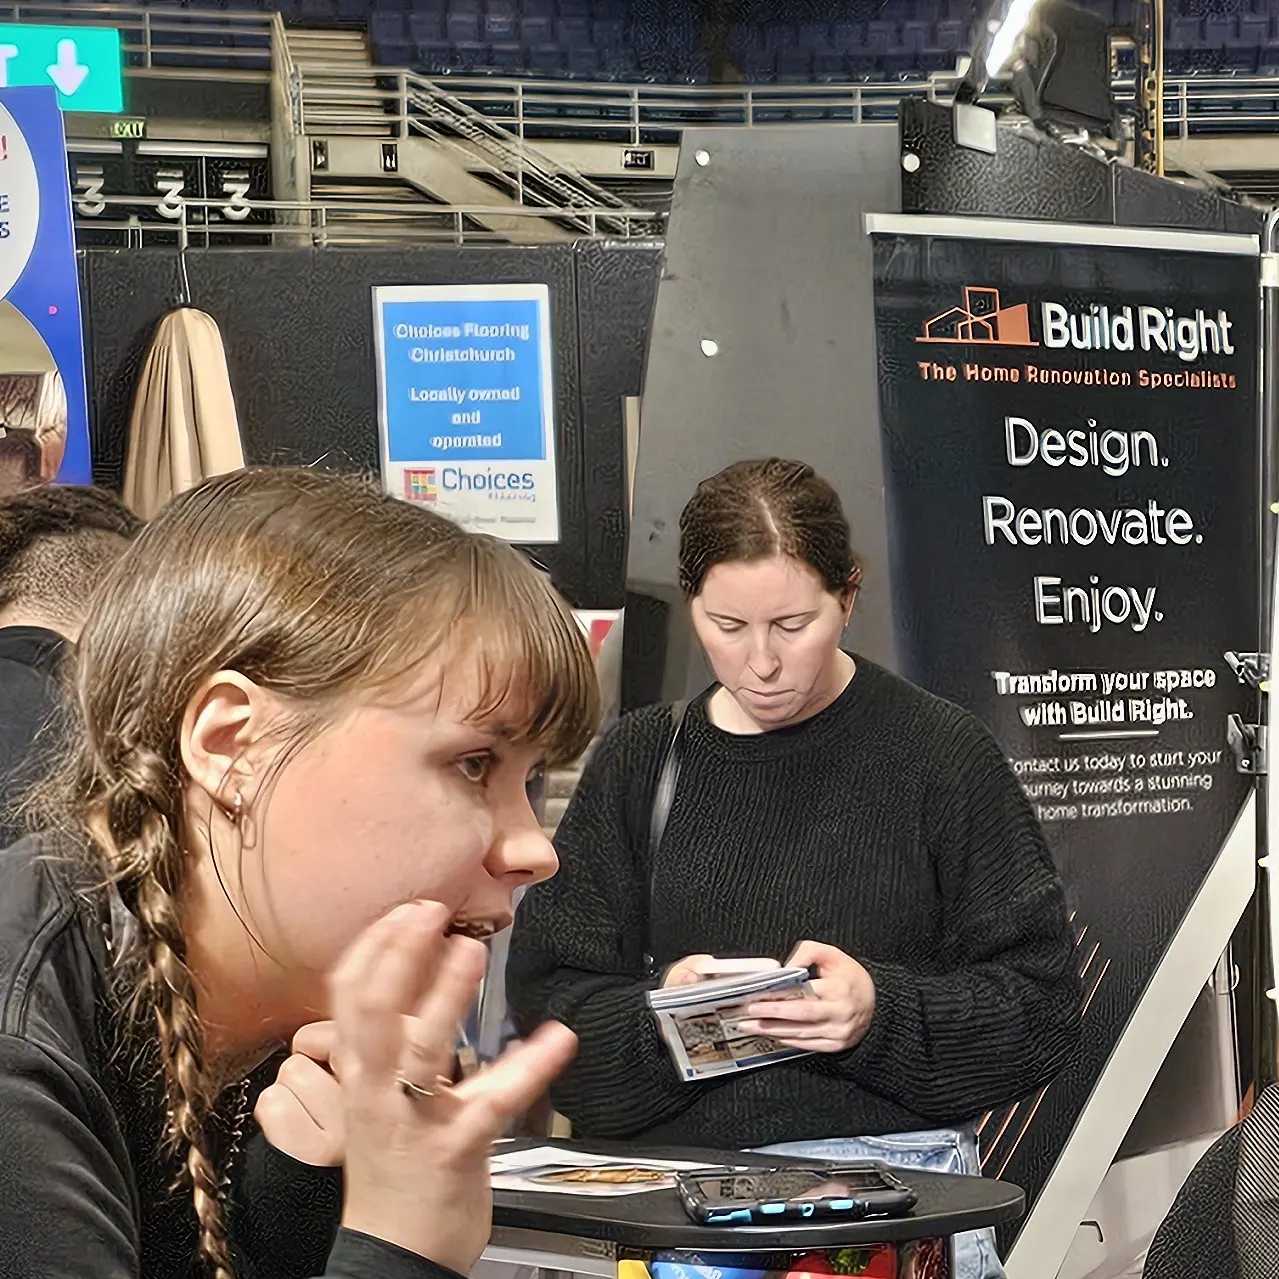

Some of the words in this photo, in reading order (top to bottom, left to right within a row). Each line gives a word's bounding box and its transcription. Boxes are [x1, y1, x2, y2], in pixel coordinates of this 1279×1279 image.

[1041, 300, 1135, 351] Build
[1138, 304, 1236, 362] Right
[916, 360, 958, 383] The
[962, 362, 1020, 384] Home
[1024, 364, 1132, 387] Renovation
[1138, 368, 1238, 390] Specialists
[451, 409, 482, 425] and
[1004, 415, 1170, 477] Design.
[441, 466, 536, 492] Choices
[982, 495, 1204, 546] Renovate.
[1033, 574, 1165, 633] Enjoy.
[992, 669, 1098, 696] Transform
[1101, 671, 1150, 696] your
[1153, 669, 1216, 693] space
[1018, 701, 1068, 728] with
[1069, 699, 1125, 725] Build
[1128, 696, 1195, 725] Right.
[1009, 756, 1061, 775] ontact
[1063, 757, 1081, 772] us
[1083, 753, 1127, 772] today
[1129, 753, 1146, 769] to
[1149, 751, 1184, 767] start
[1187, 750, 1223, 770] your
[1022, 781, 1070, 800] urney
